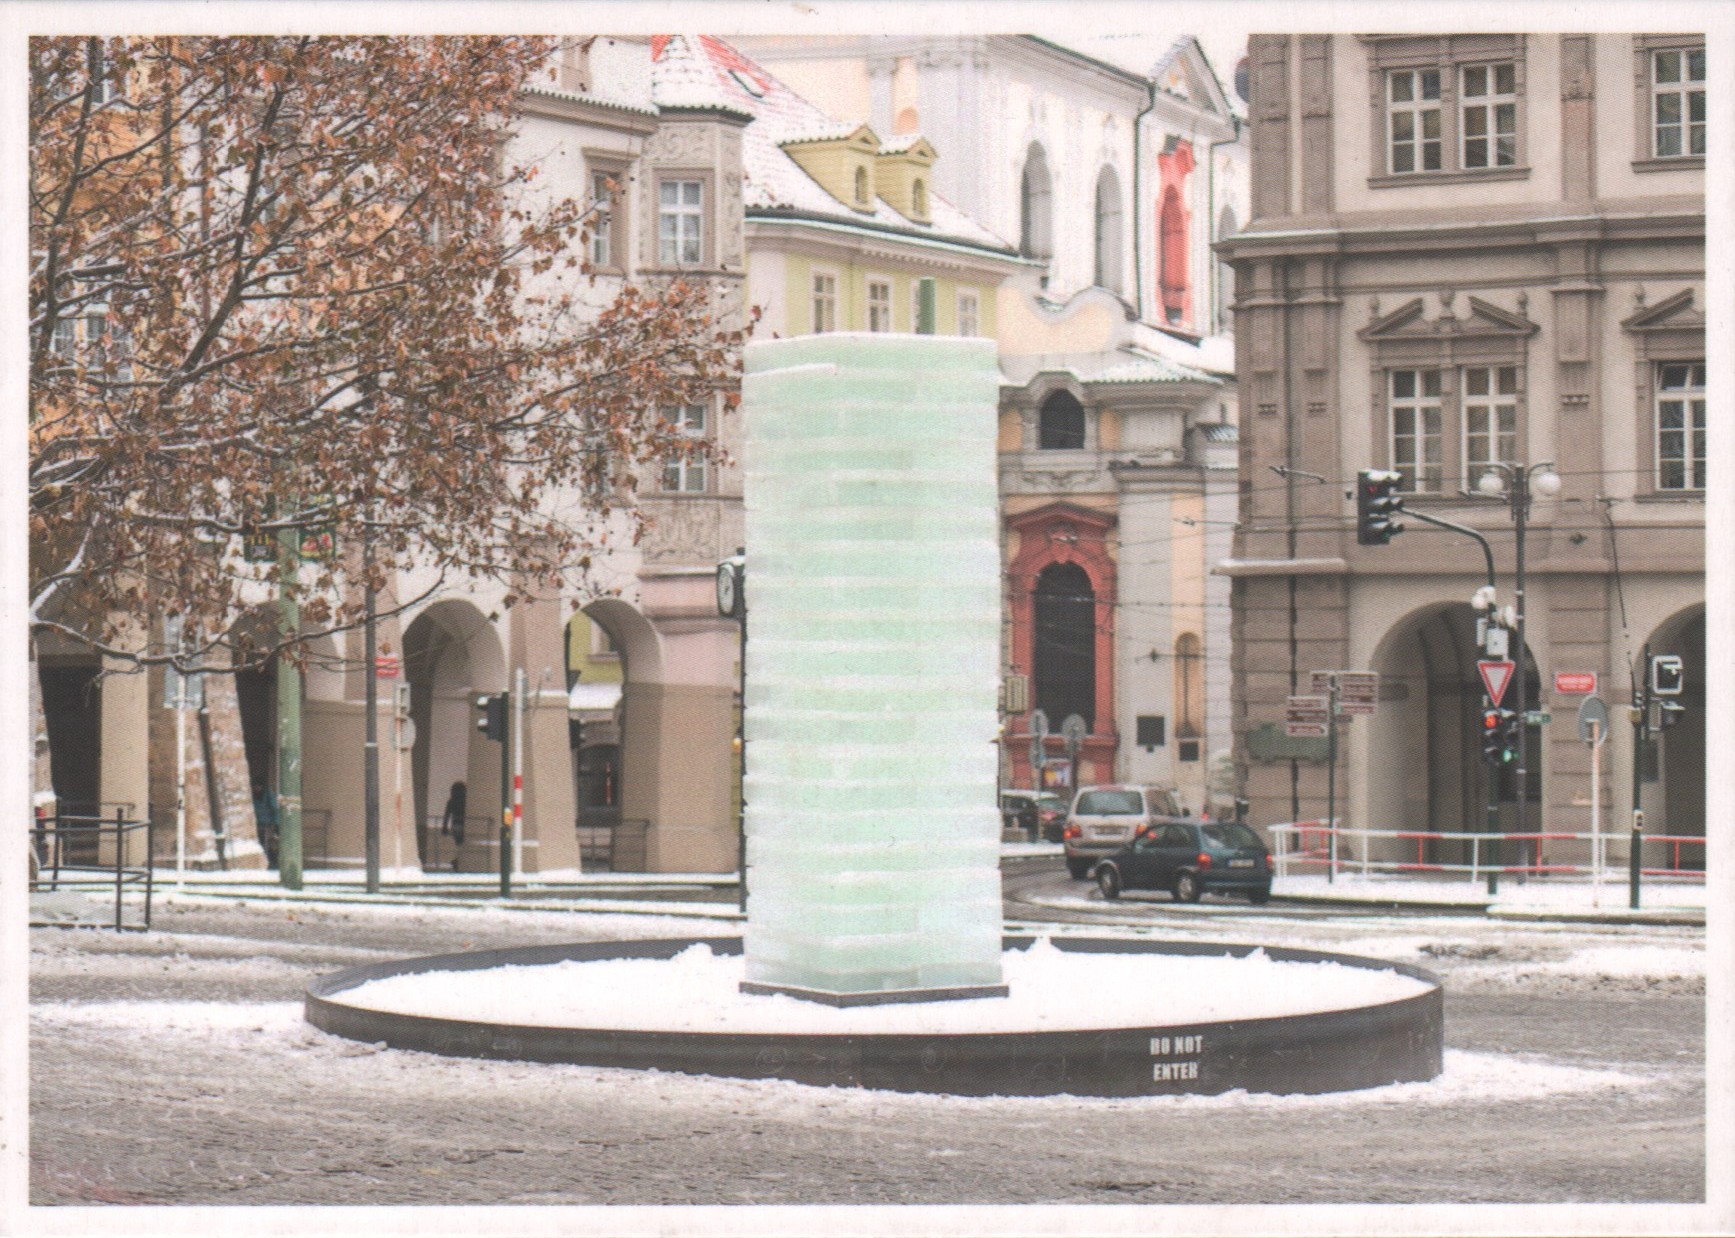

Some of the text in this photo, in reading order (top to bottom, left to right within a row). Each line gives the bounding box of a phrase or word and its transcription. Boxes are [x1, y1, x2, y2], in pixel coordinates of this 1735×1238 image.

[1150, 1035, 1203, 1055] DO NOT
[1153, 1062, 1199, 1081] ENTER
